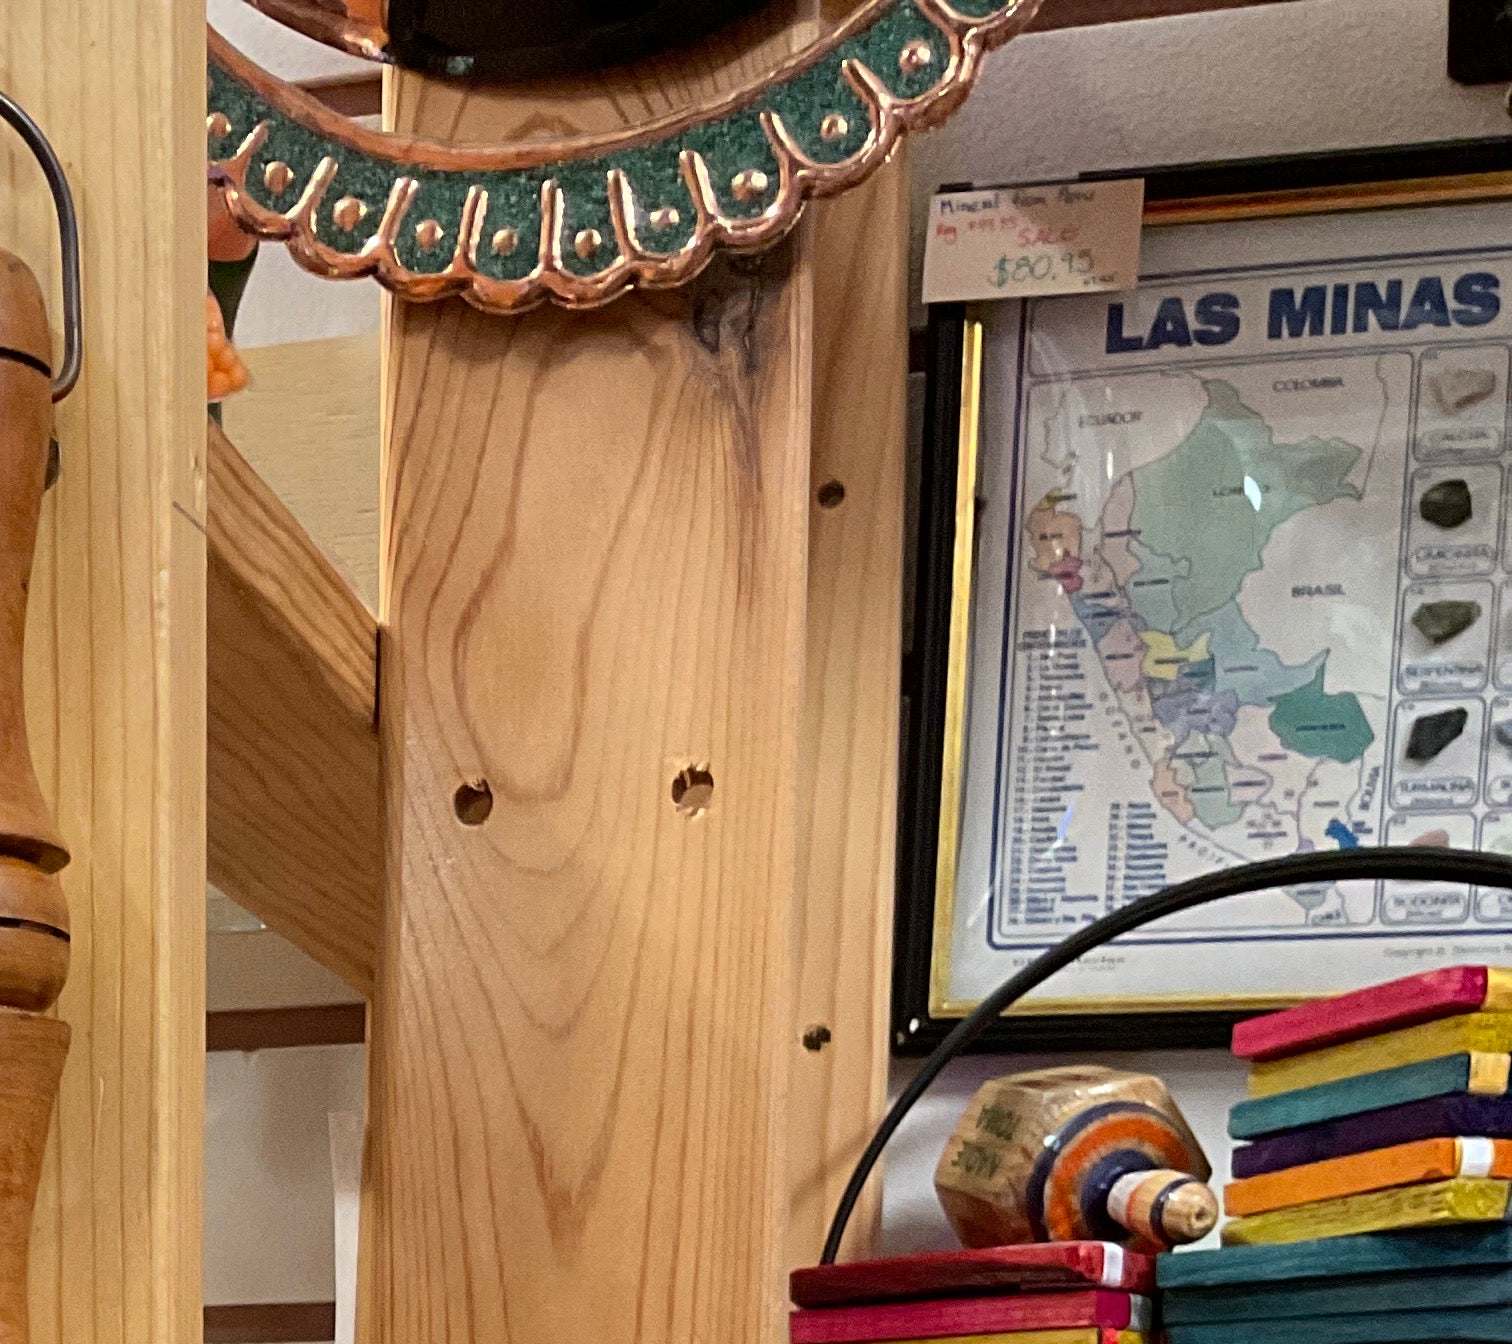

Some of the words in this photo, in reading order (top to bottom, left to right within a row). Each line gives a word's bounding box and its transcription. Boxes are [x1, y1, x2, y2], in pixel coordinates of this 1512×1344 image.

[1104, 293, 1240, 356] LAS
[1267, 272, 1501, 340] MINAS
[1291, 584, 1346, 598] BRASIL
